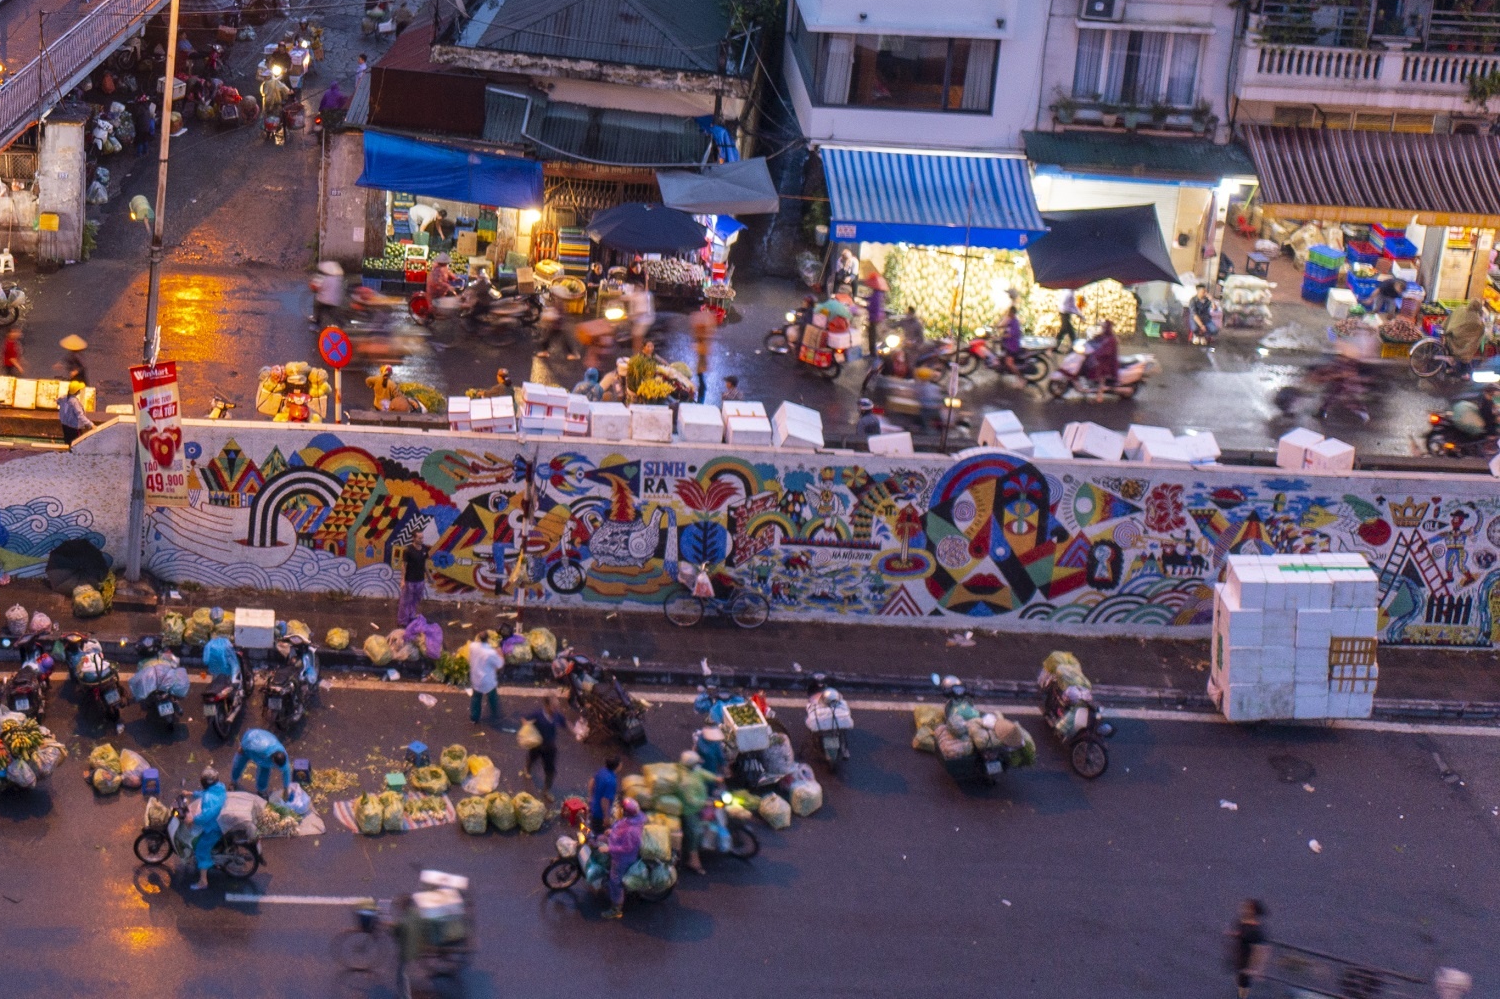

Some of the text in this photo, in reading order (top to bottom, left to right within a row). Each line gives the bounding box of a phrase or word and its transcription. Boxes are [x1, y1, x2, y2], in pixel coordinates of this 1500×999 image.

[133, 367, 169, 381] WinMart
[643, 461, 686, 477] SINH
[644, 477, 668, 493] RA
